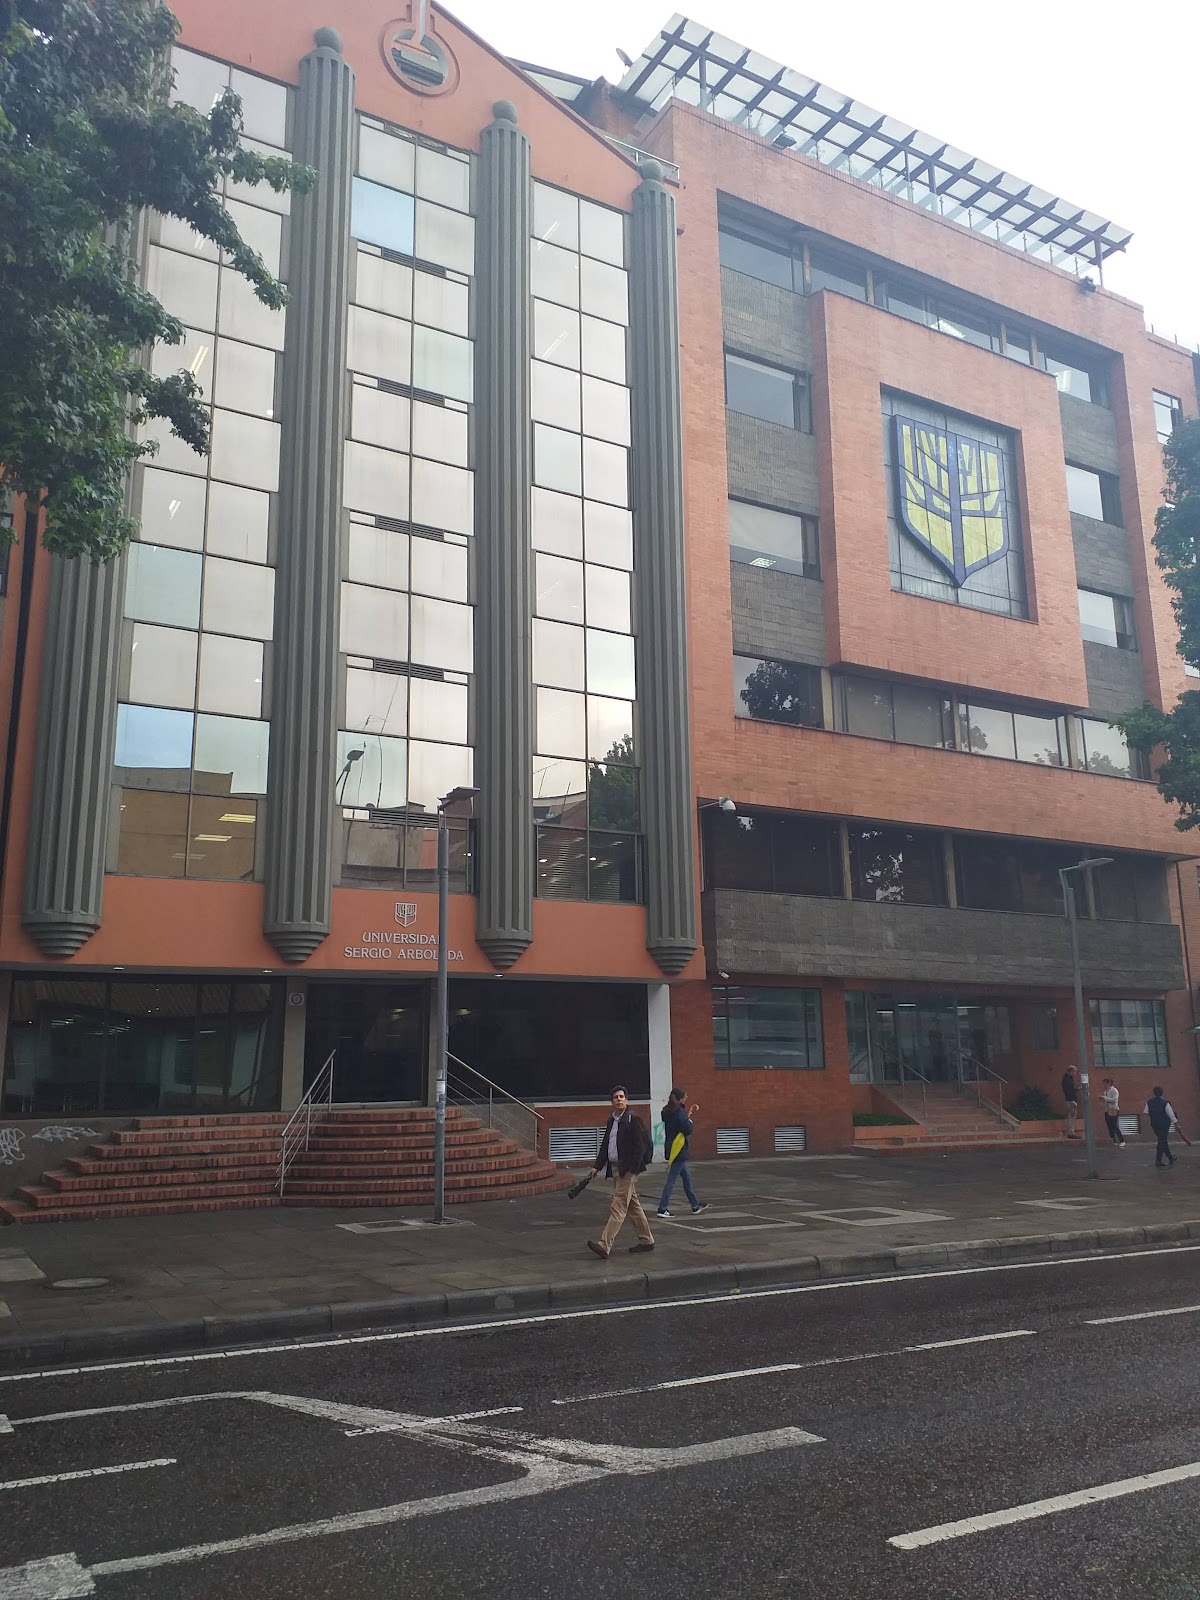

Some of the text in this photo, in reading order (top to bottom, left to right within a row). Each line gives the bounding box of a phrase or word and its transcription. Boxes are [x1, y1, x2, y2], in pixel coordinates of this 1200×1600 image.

[362, 931, 440, 945] UNIVERSIDA
[344, 946, 464, 961] SERGIO ARBOLDA
